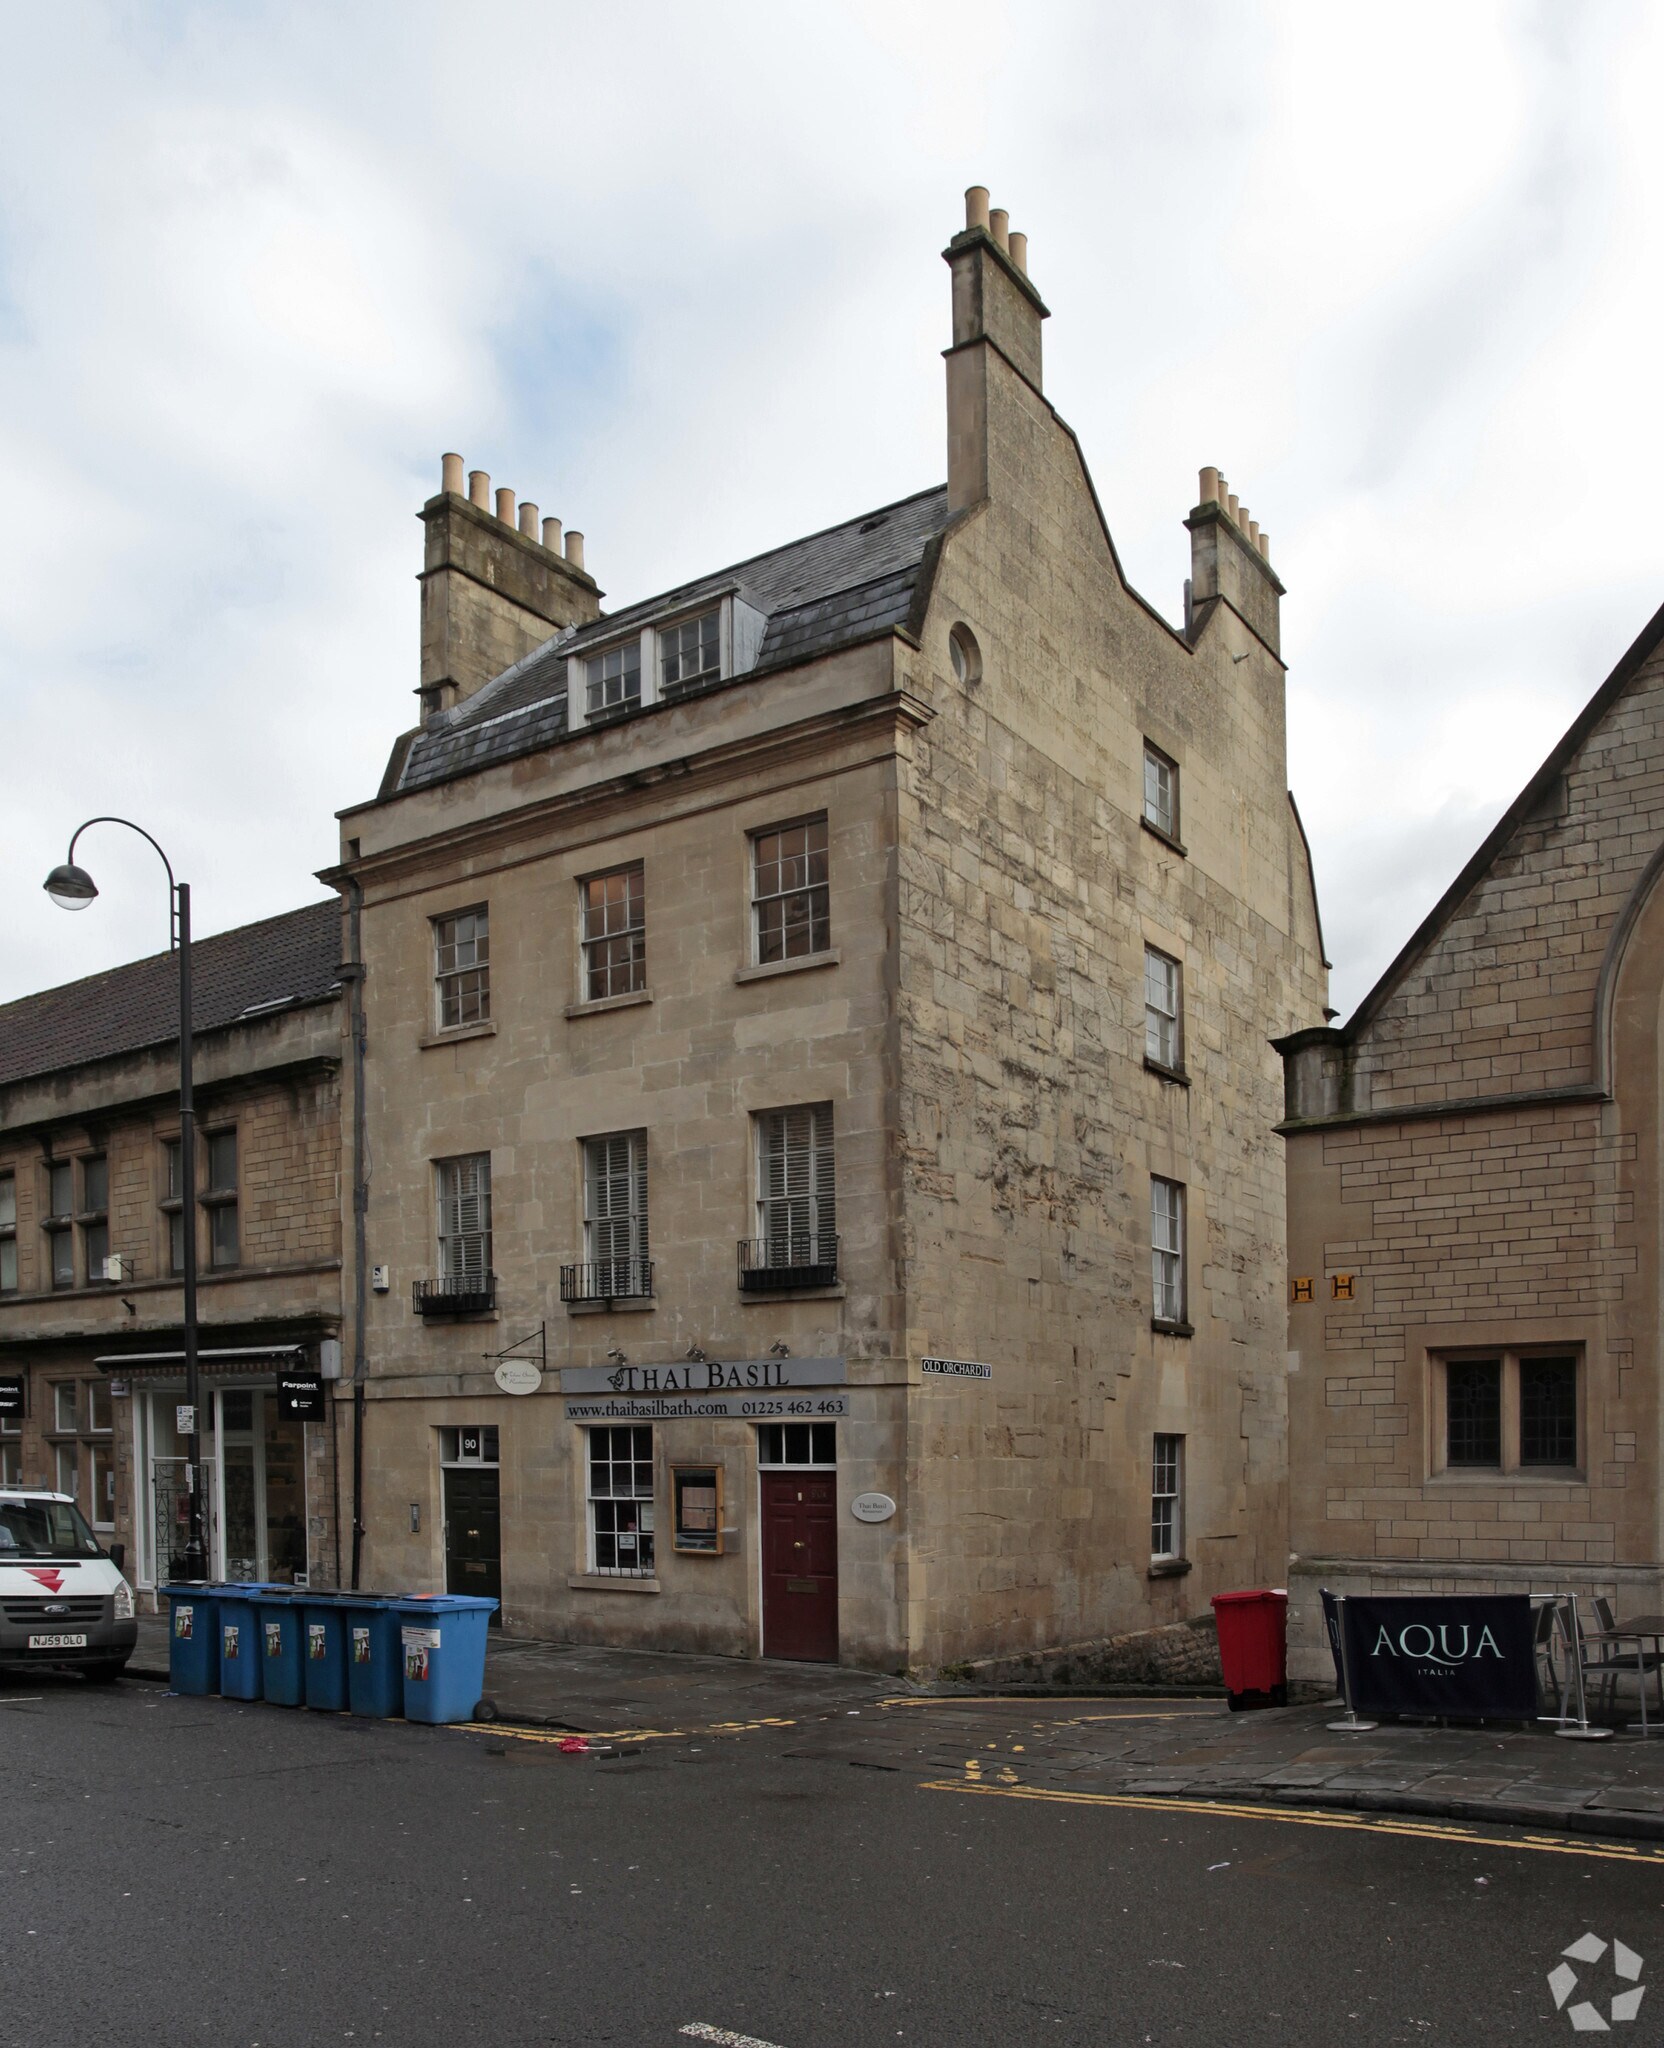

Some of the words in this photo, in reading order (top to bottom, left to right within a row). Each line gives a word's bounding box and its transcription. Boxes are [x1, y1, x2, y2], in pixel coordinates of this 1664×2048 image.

[1292, 1279, 1314, 1301] H
[1333, 1275, 1354, 1299] H
[923, 1361, 941, 1372] OLD
[943, 1362, 982, 1376] ORCHARD
[623, 1366, 691, 1391] THAI
[706, 1363, 789, 1388] BASIL
[282, 1381, 318, 1390] Farpoint
[568, 1399, 728, 1417] www.thaibasilbath.com
[742, 1401, 783, 1414] 01225
[787, 1400, 813, 1414] 462
[817, 1400, 844, 1414] 463
[464, 1438, 477, 1449] 90
[33, 1636, 61, 1646] NJ59
[1370, 1624, 1506, 1666] AQUA
[1418, 1668, 1456, 1676] ITALIA
